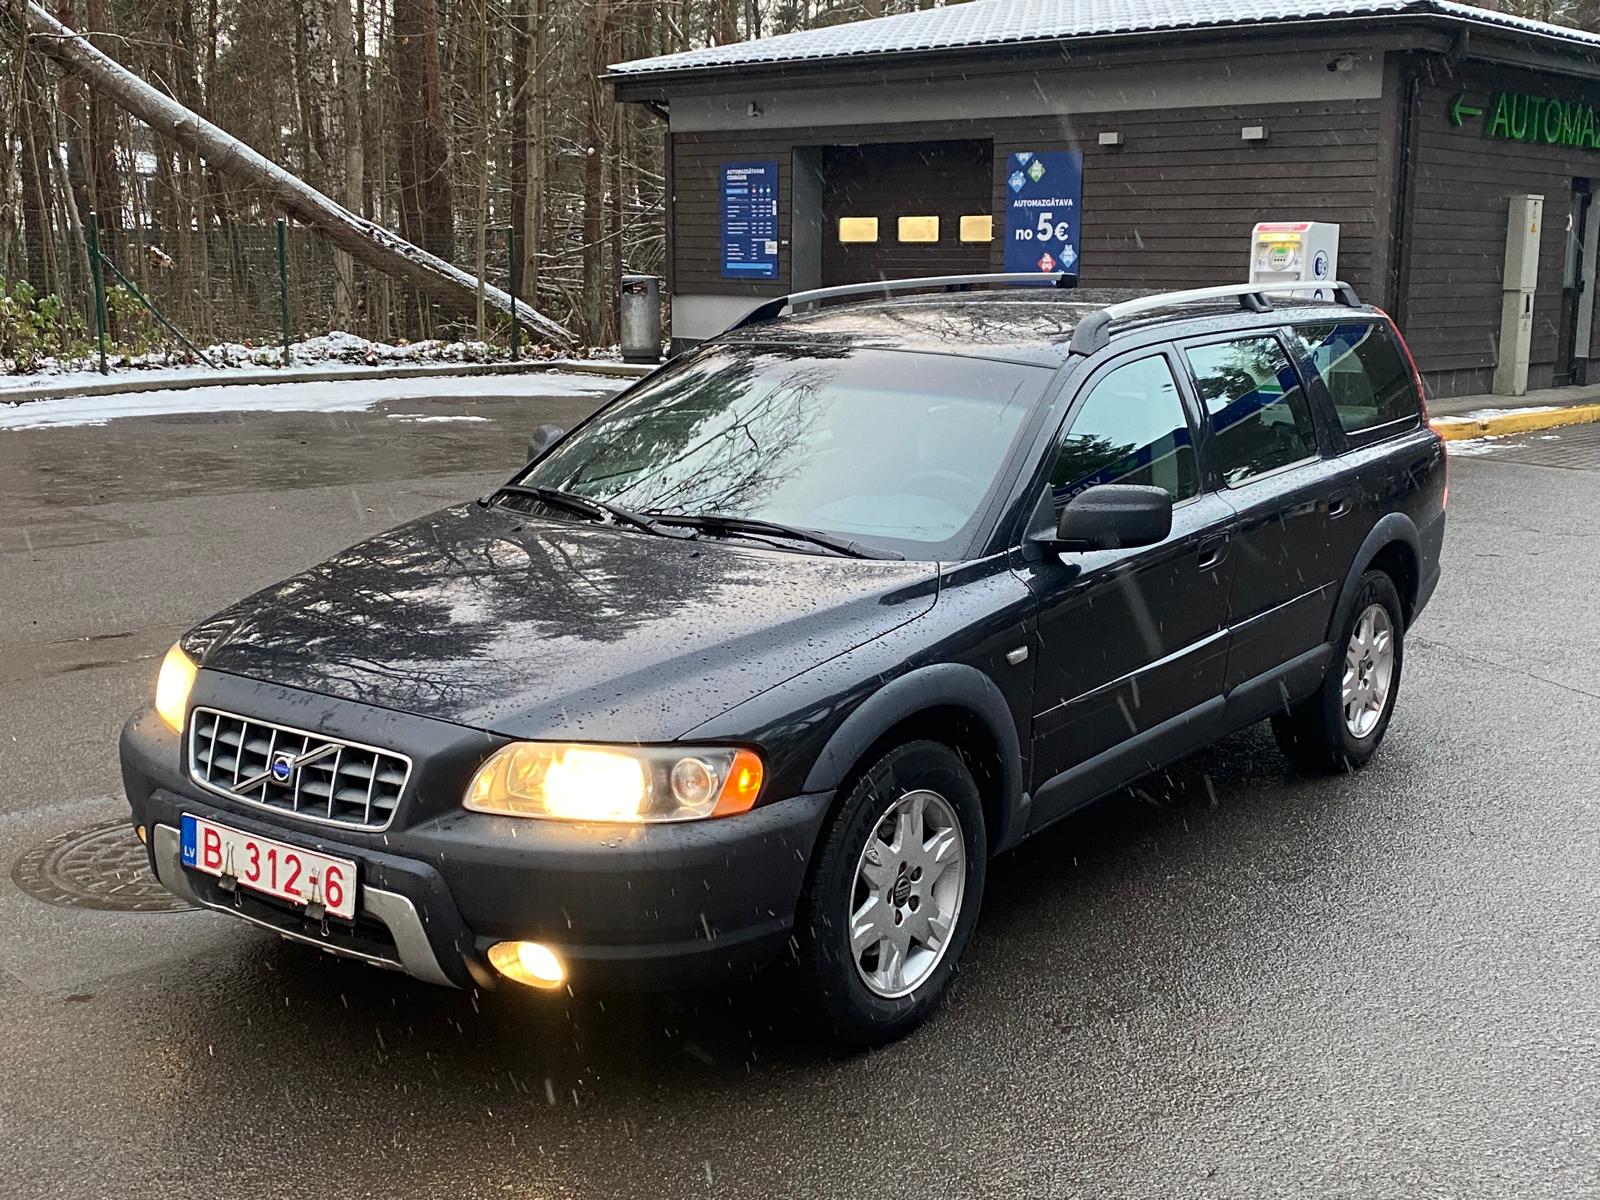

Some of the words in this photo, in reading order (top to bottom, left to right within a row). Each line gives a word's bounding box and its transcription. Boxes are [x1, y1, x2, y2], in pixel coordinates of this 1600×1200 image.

[1490, 92, 1600, 148] AUTOMA
[1013, 197, 1073, 207] AUTOMAZGĀTAVA
[1015, 228, 1033, 240] no
[1037, 212, 1069, 241] 5€
[184, 845, 196, 858] LV
[203, 827, 222, 870] B
